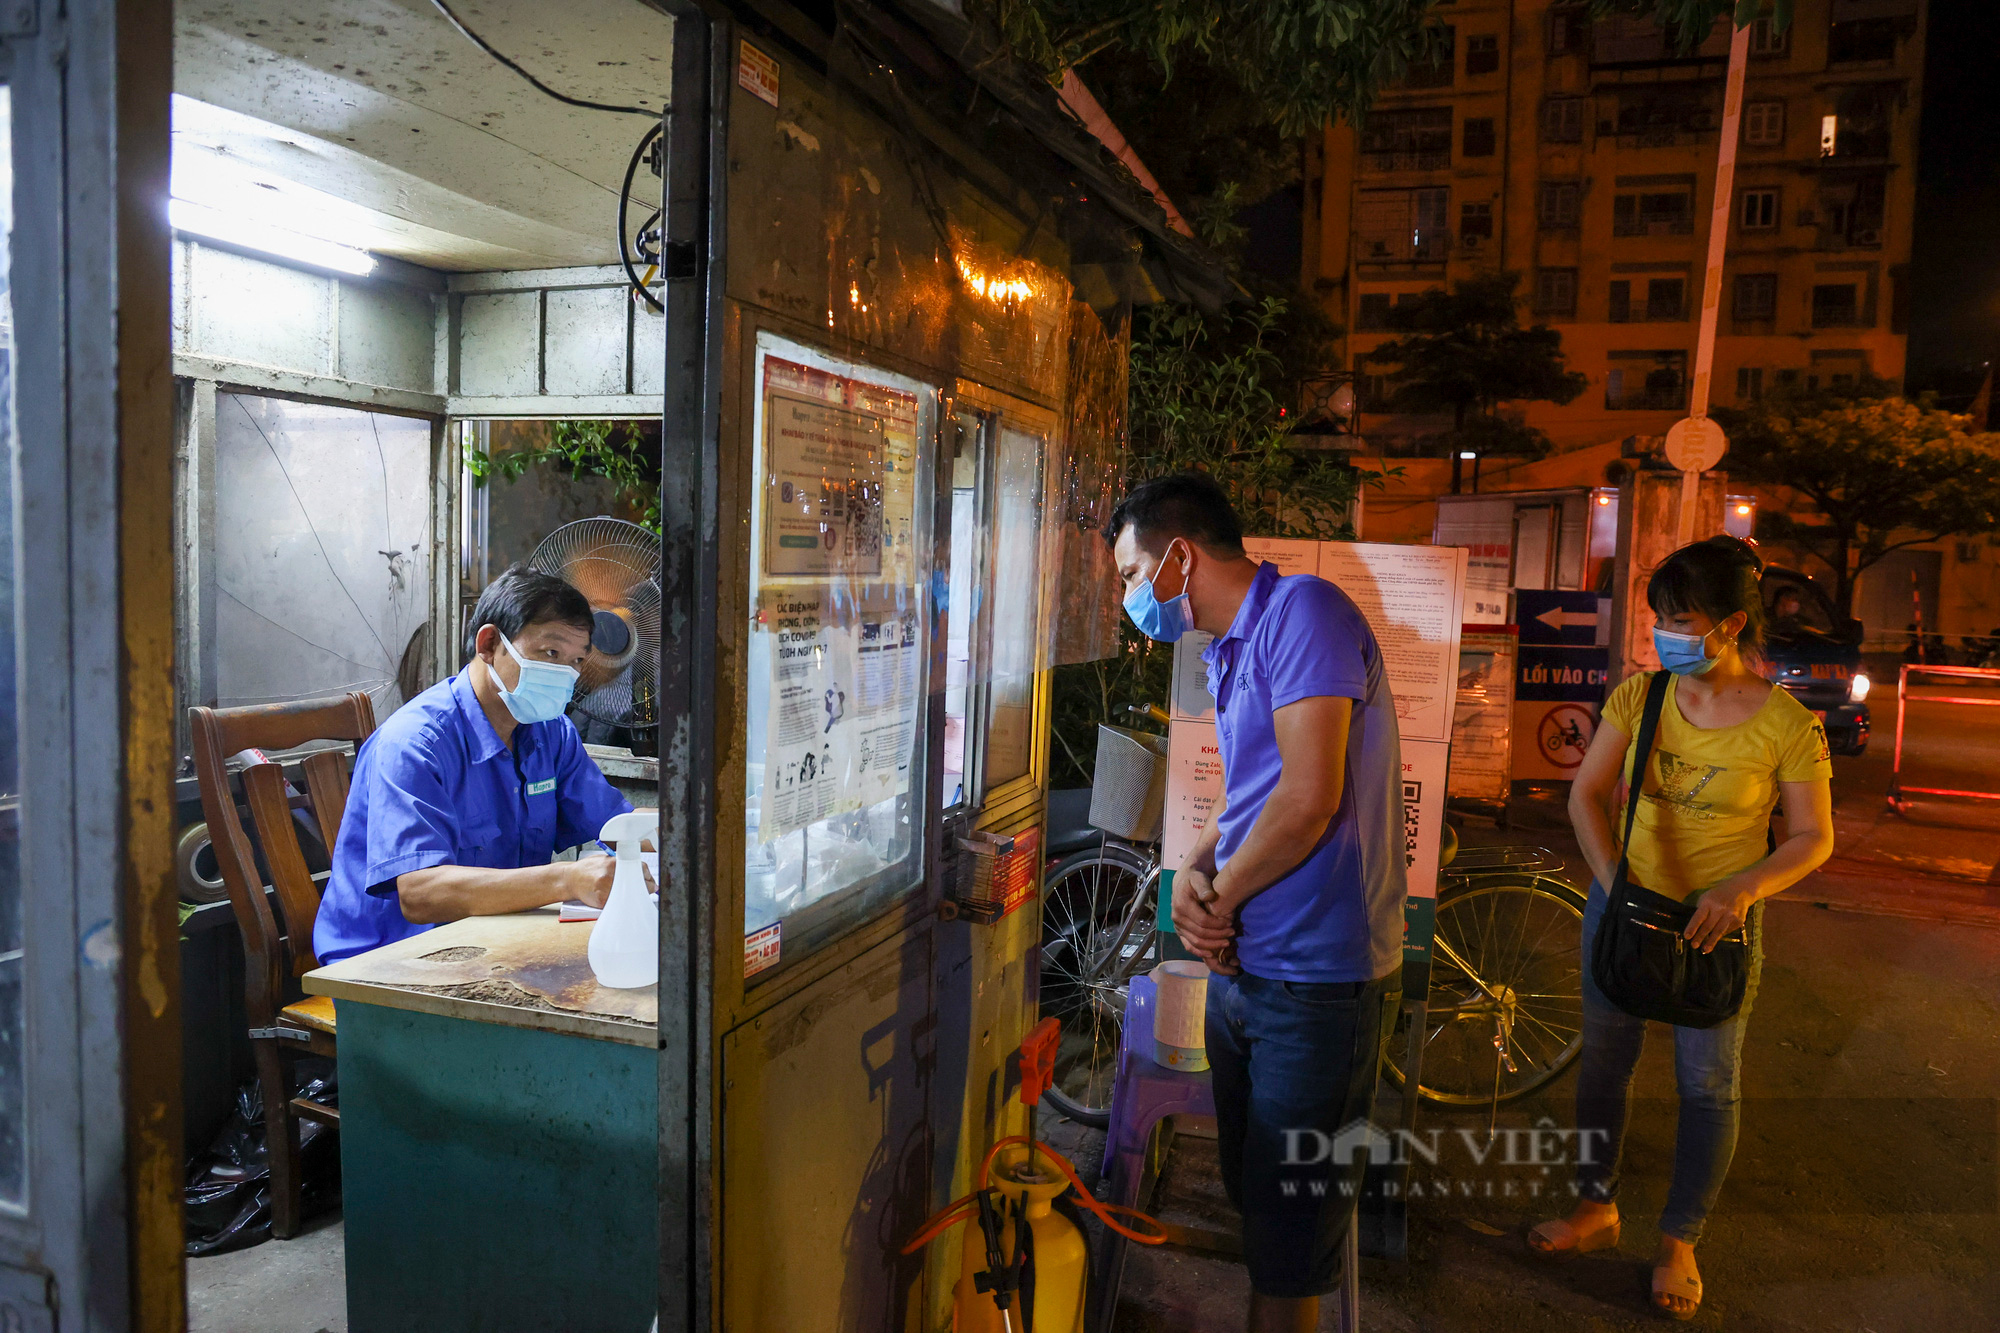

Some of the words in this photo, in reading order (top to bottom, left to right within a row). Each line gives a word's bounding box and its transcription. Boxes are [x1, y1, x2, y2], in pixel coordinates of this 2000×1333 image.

[789, 601, 805, 615] BIỆN
[1523, 663, 1548, 684] LỐI
[1552, 665, 1583, 685] VÀO
[533, 782, 551, 792] Hapro
